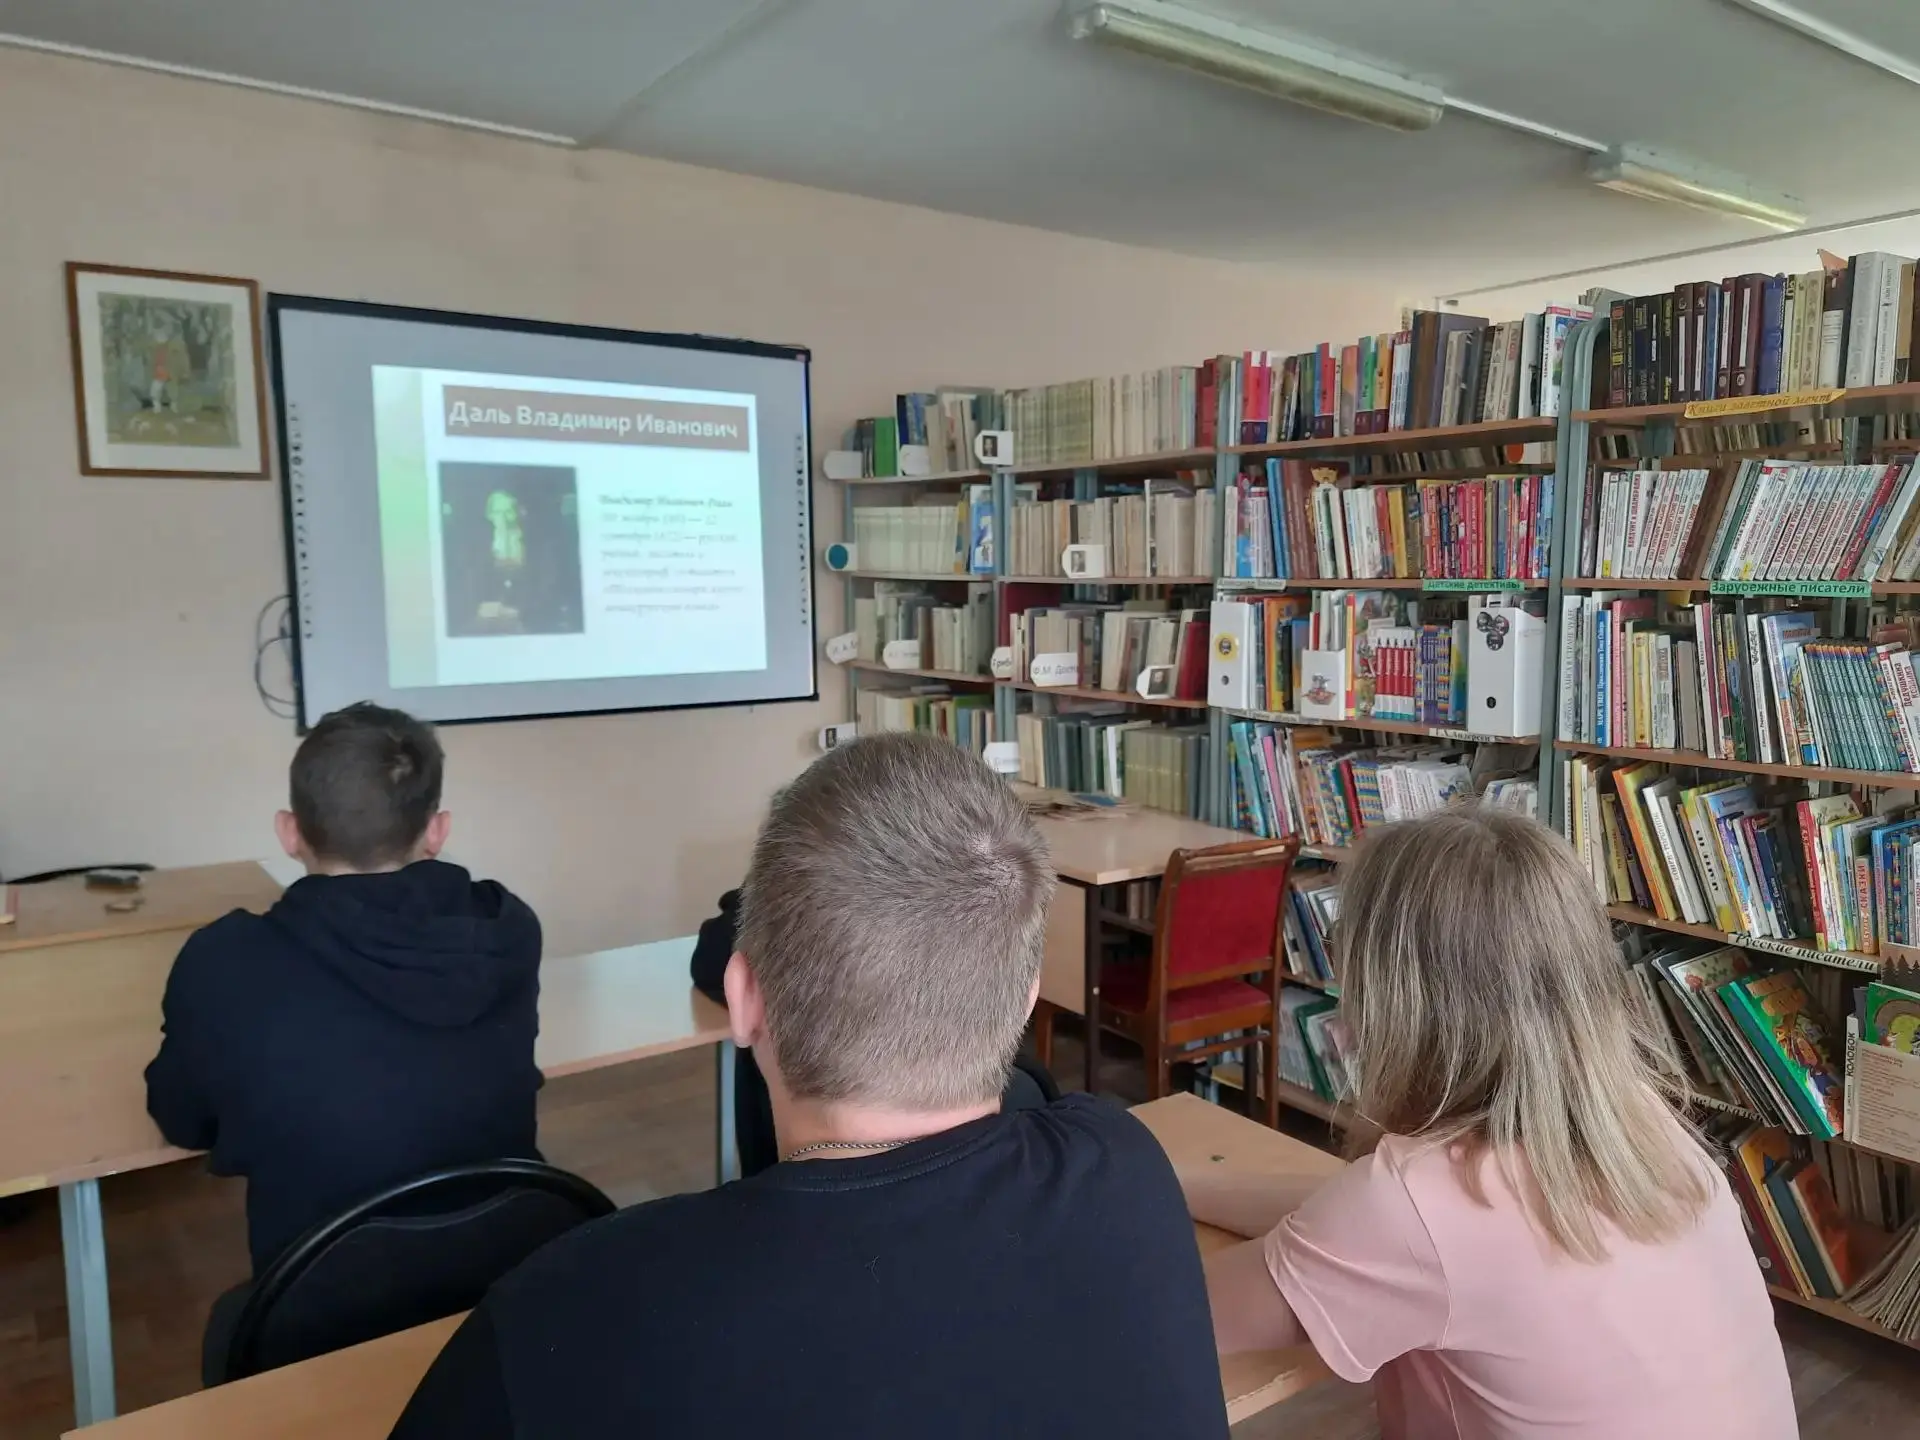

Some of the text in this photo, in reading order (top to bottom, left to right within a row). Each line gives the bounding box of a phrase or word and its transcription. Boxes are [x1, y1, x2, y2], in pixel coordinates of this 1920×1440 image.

[449, 401, 738, 438] Даль Владимир Иванович
[1712, 581, 1865, 595] Зарубежные писатели
[1857, 865, 1868, 909] СКАЗКИ
[1735, 934, 1875, 971] Русские писатели
[1846, 1032, 1856, 1077] КОЛОБОК
